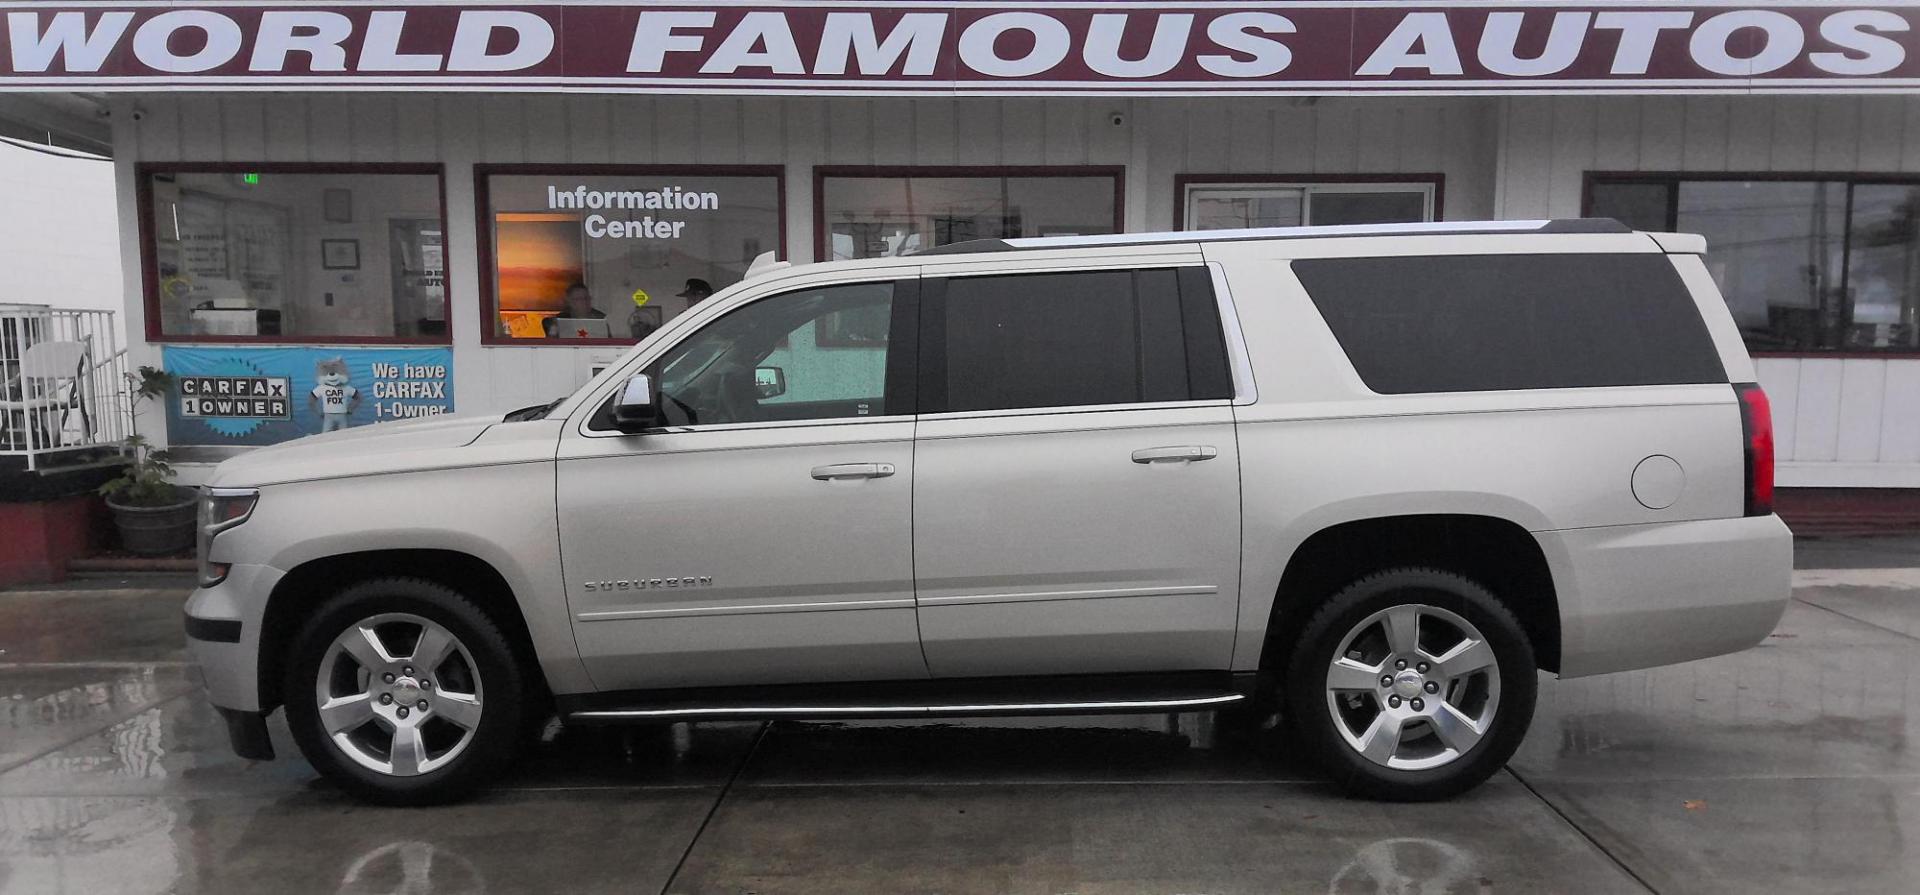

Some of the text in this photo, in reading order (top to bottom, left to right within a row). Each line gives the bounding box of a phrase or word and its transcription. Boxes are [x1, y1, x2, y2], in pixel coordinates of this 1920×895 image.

[7, 9, 1909, 77] WORLD FAMOUS AUTOS
[547, 186, 719, 210] Information
[585, 214, 685, 239] Center
[372, 363, 446, 379] We have
[181, 378, 286, 397] CARFAX
[325, 389, 344, 397] CAR
[373, 381, 446, 399] CARFAX
[327, 397, 344, 405] FOX
[374, 402, 447, 418] 1-Owner
[584, 576, 713, 592] SUBURBAN
